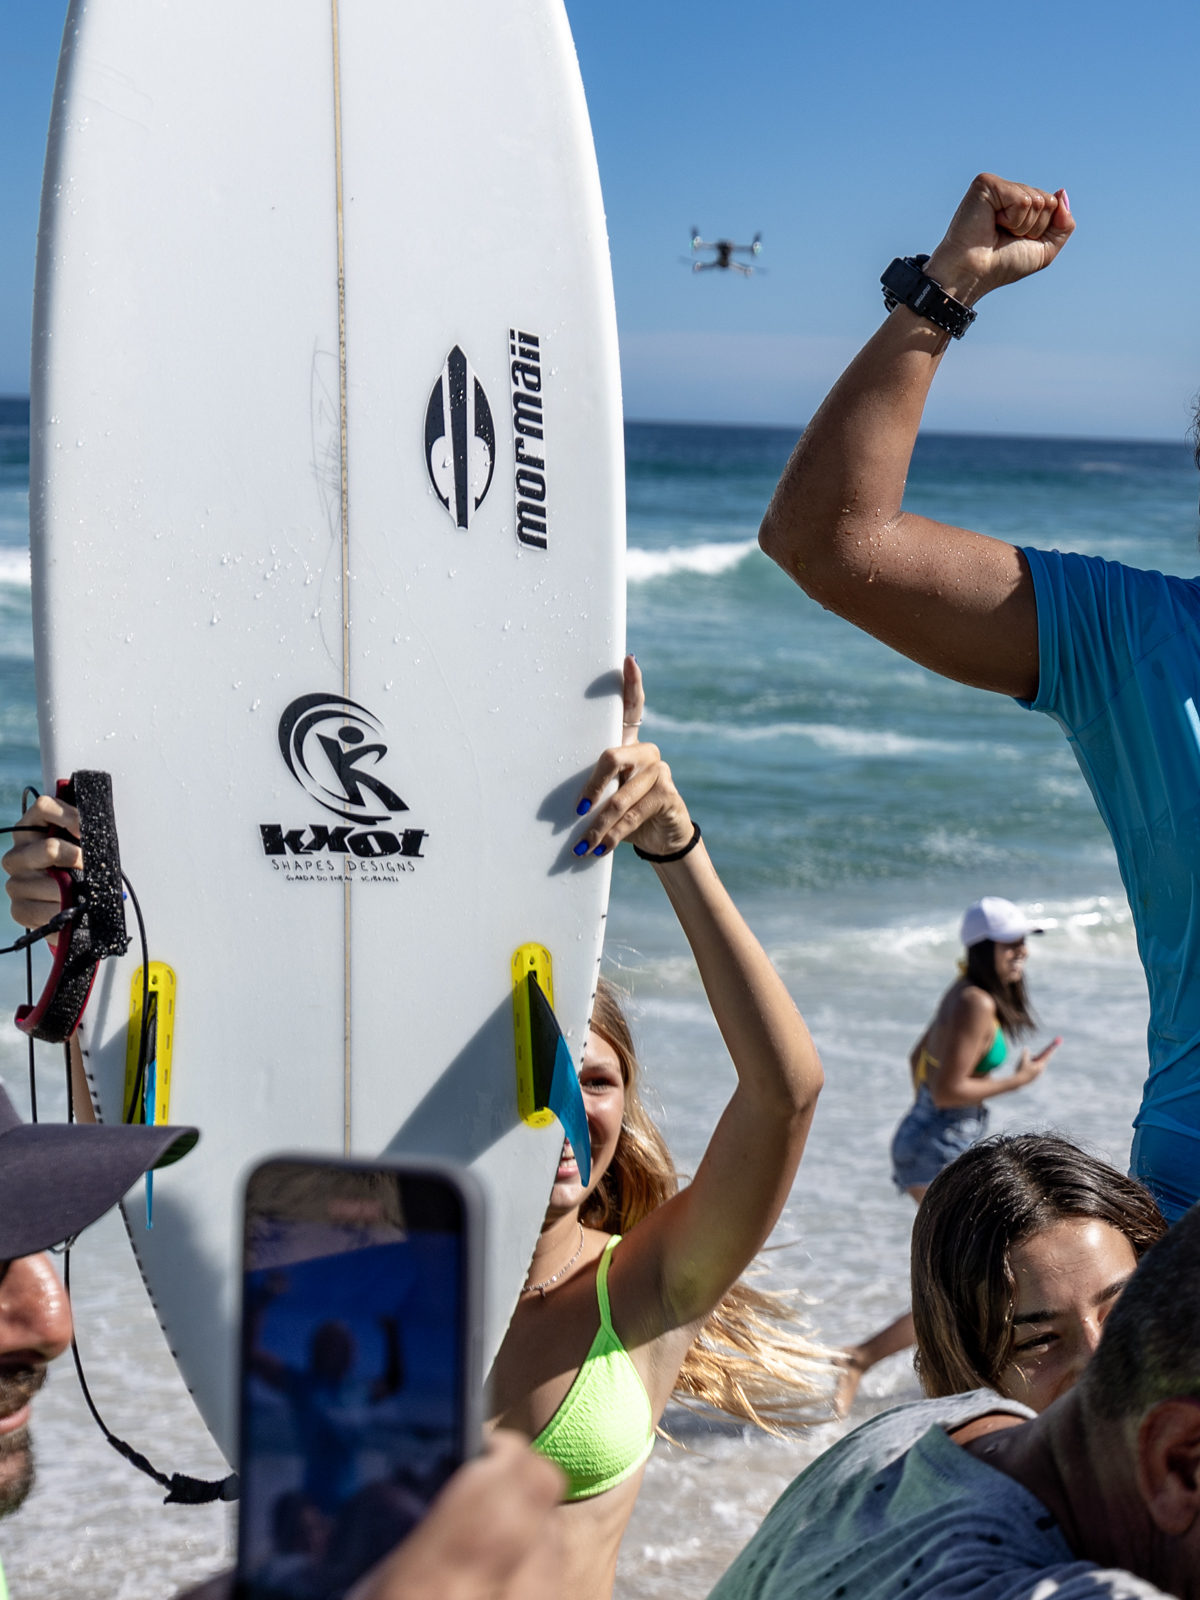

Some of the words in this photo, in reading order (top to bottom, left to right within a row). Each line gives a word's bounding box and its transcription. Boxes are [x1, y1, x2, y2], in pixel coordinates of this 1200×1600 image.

[509, 328, 548, 550] mormaii
[271, 859, 335, 872] SHAPES
[347, 860, 416, 873] DESIGNS
